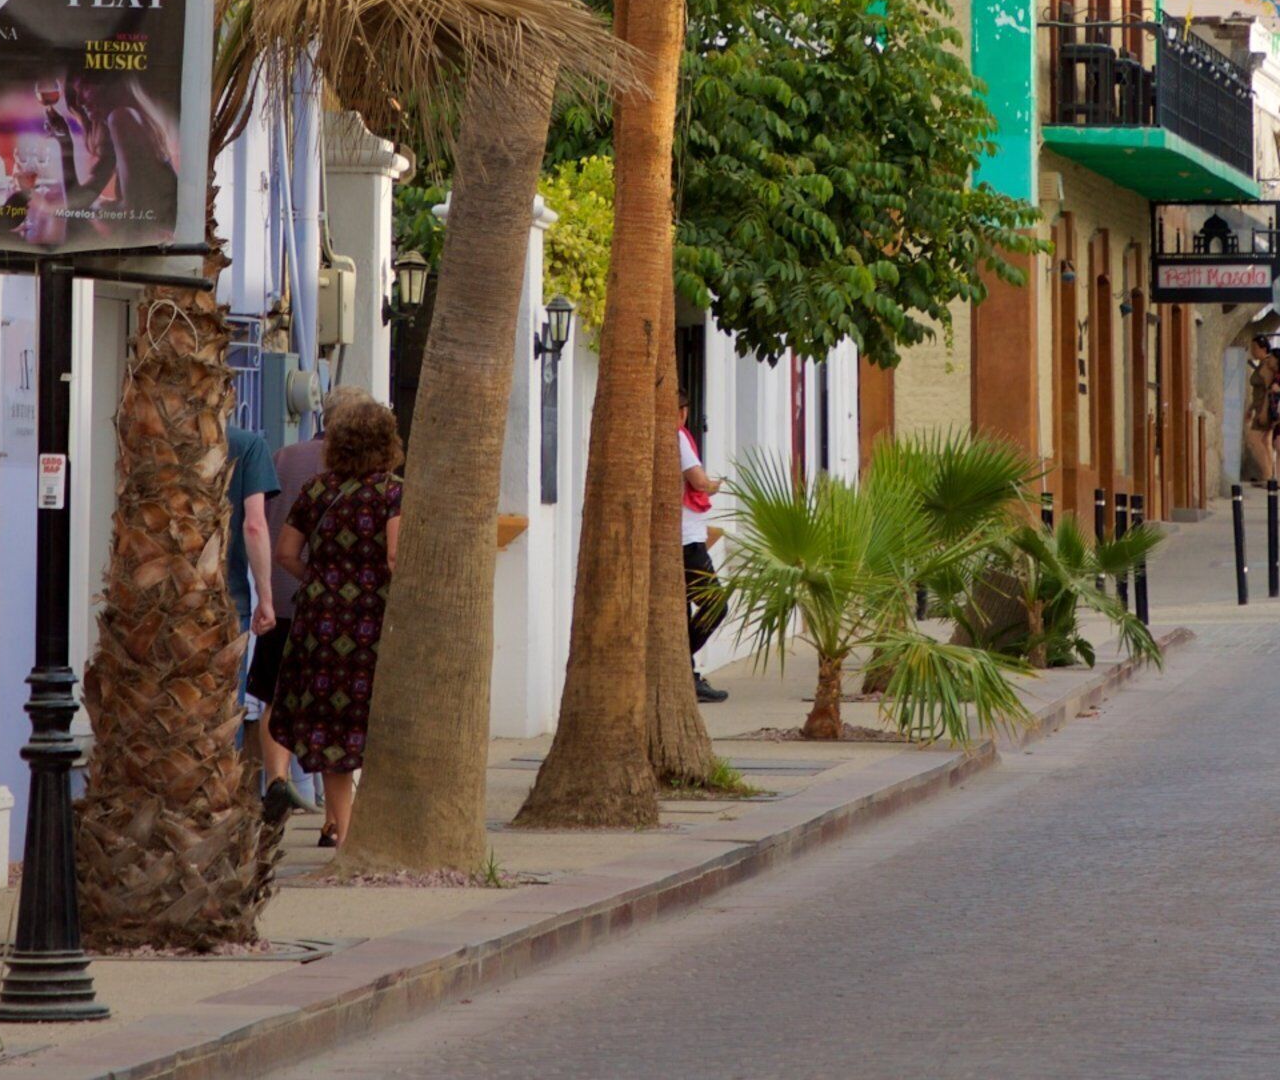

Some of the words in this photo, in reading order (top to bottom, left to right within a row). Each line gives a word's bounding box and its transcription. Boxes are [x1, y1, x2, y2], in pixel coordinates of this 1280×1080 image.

[85, 40, 146, 53] TUESDAY
[84, 53, 148, 70] MUSIC
[5, 205, 26, 217] 7pm
[55, 208, 95, 219] Morelos
[98, 209, 126, 219] Street
[129, 209, 157, 220] S.J.C.
[1207, 265, 1266, 288] Masala
